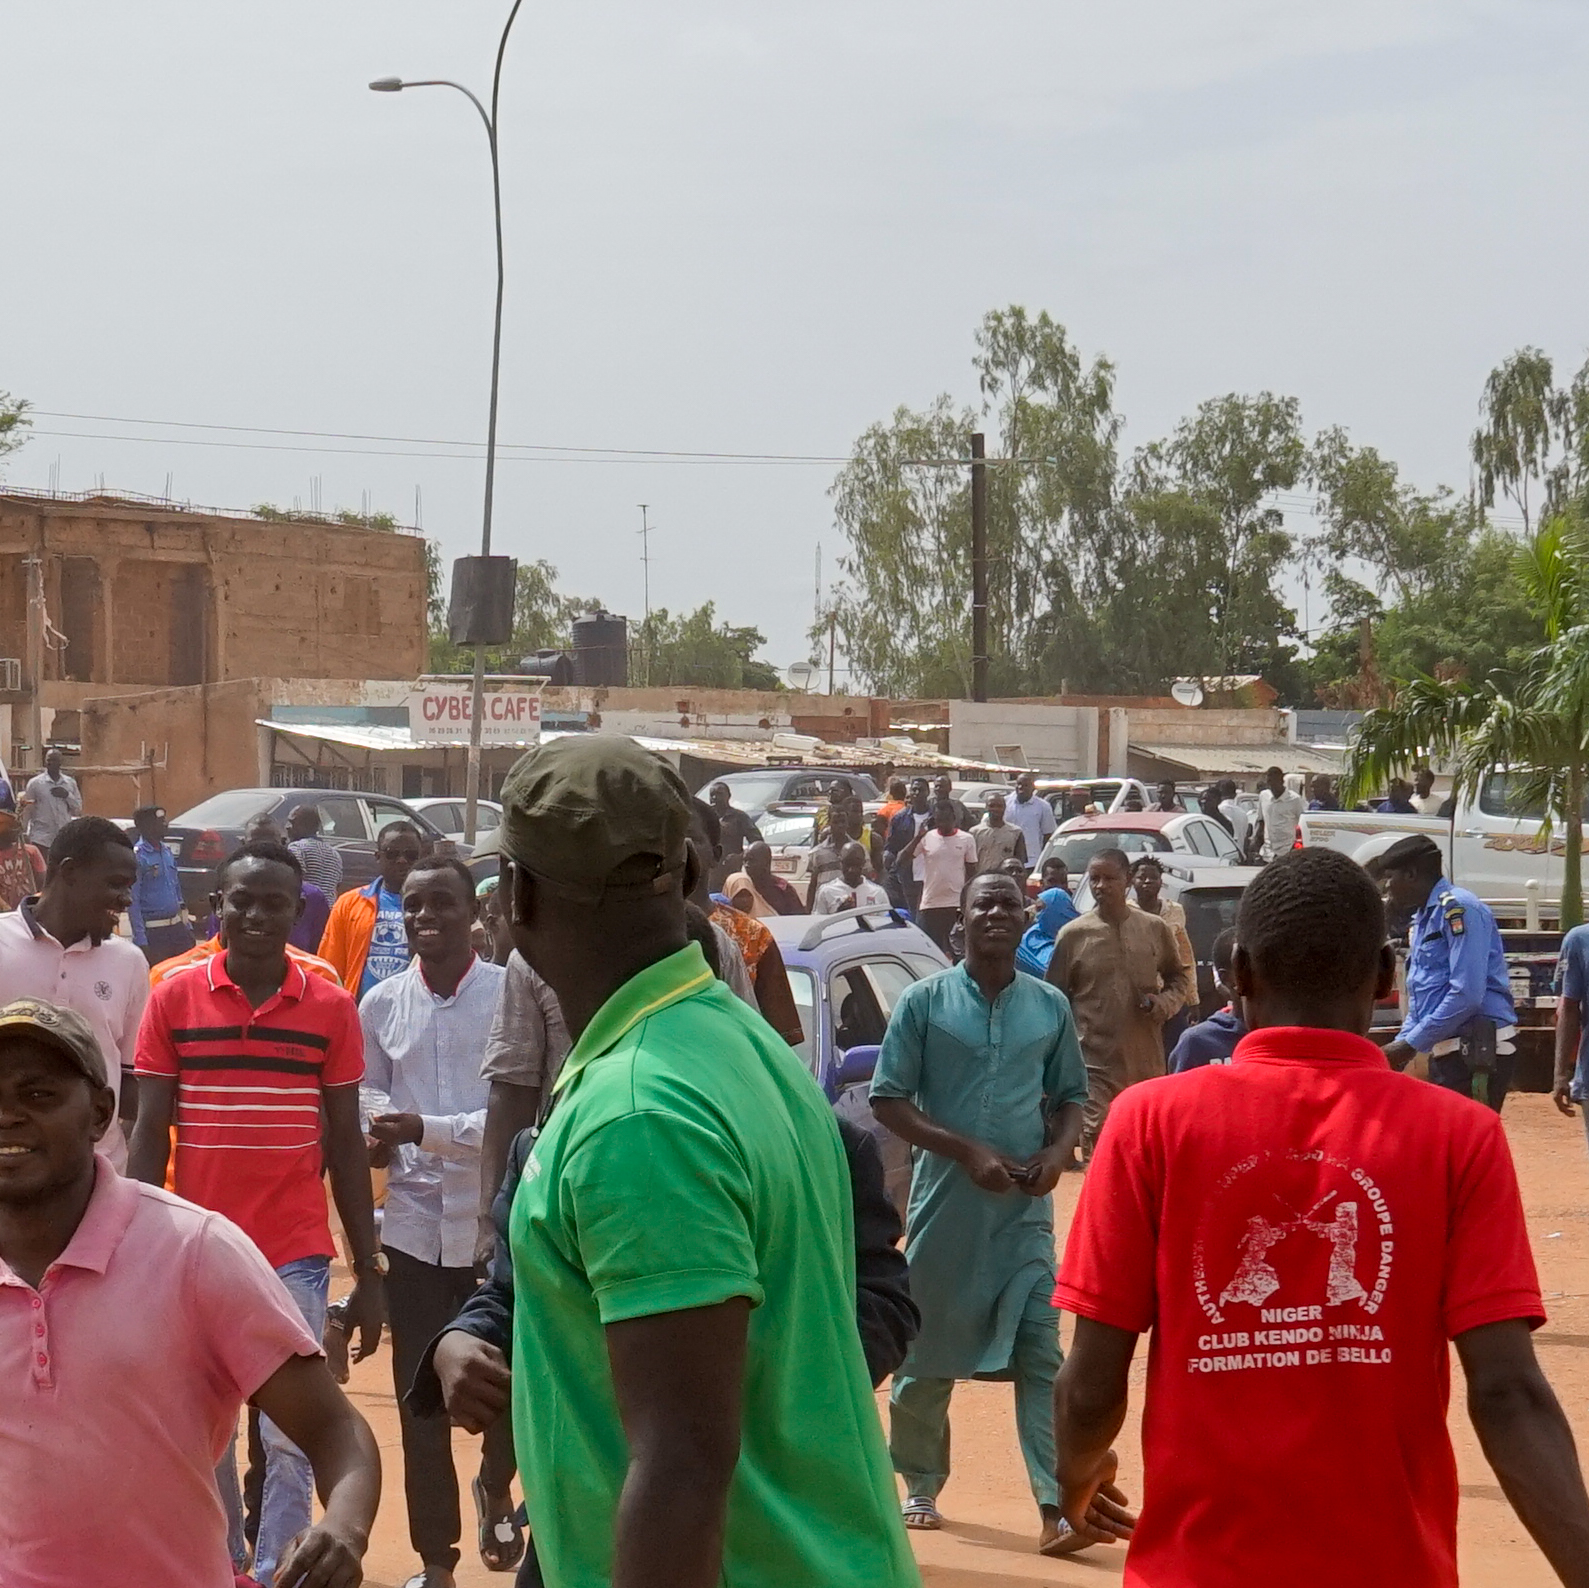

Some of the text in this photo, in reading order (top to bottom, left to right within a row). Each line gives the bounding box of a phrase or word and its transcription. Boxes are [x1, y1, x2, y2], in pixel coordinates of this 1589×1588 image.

[490, 697, 540, 721] CAFE
[1351, 1168, 1393, 1236] GROUPE
[1363, 1240, 1394, 1315] DANGER
[1261, 1305, 1323, 1323] NIGER
[1198, 1324, 1384, 1350] CLUB KENDO NINJA
[1187, 1347, 1392, 1373] FORMATION DE BELLO
